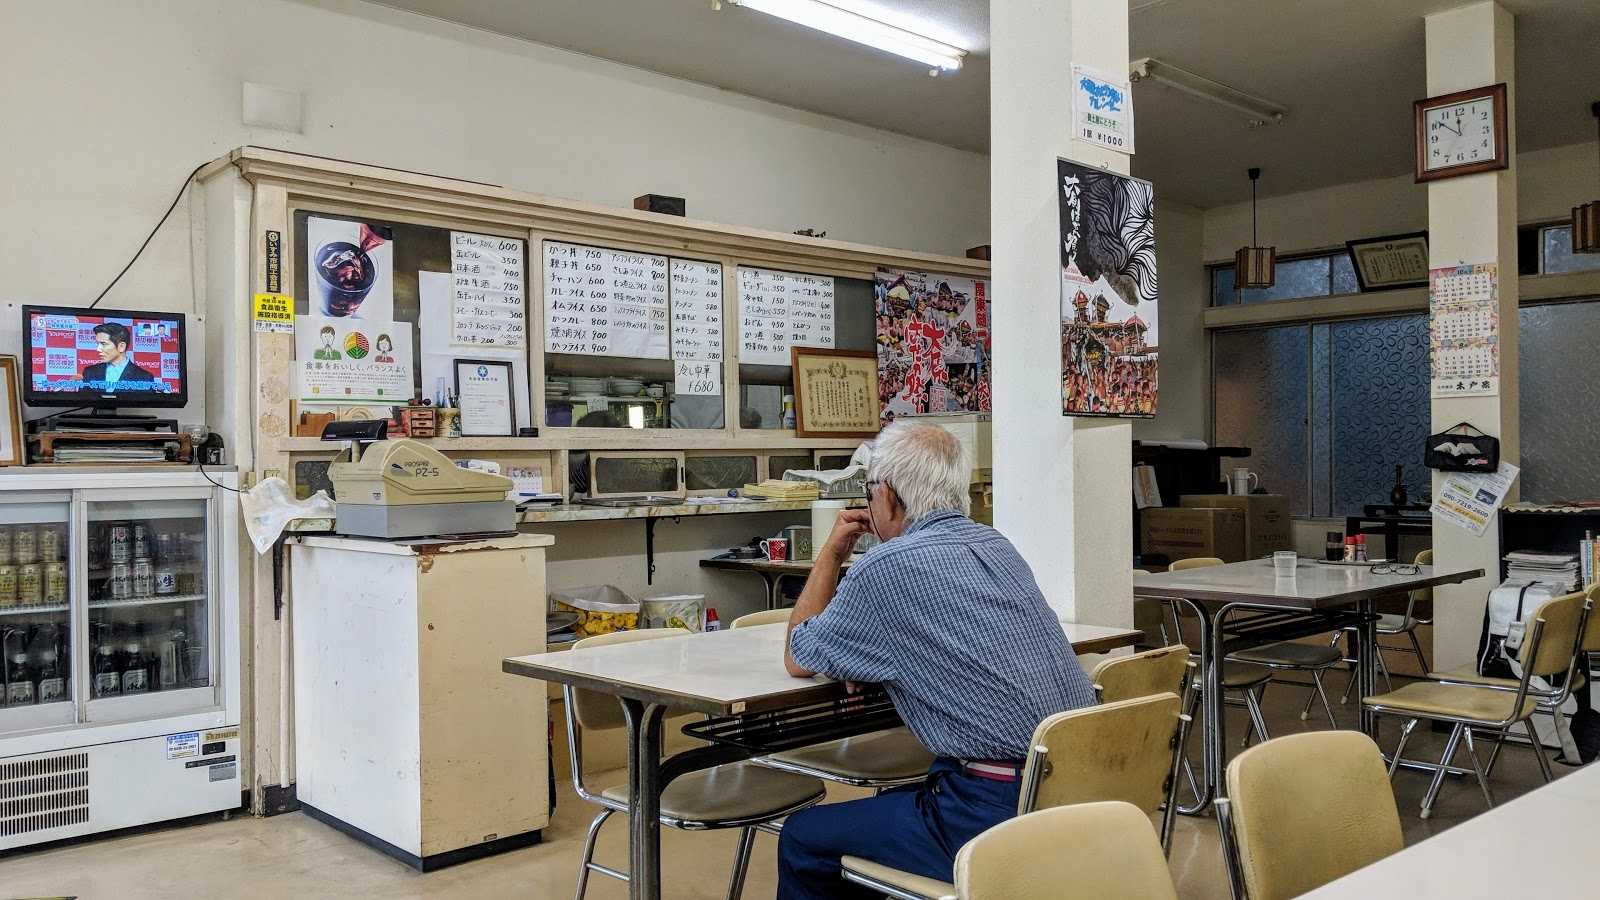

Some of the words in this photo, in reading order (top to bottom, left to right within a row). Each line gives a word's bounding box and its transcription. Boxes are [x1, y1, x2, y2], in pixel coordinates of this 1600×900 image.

[498, 241, 518, 251] 600
[549, 246, 577, 257] かつ丼
[585, 249, 602, 259] 750
[500, 257, 518, 265] 350
[551, 258, 578, 271] 親子丼
[585, 263, 602, 271] 650
[457, 264, 480, 274] 日本酒
[503, 268, 519, 277] 400
[551, 272, 583, 284] チャーハン
[588, 277, 605, 286] 600
[503, 281, 519, 291] 750
[551, 287, 585, 298] カレーライス
[590, 290, 607, 299] 600
[503, 296, 520, 305] 350
[552, 300, 585, 312] オムライス
[509, 310, 523, 319] 300
[651, 309, 665, 318] 750
[552, 316, 585, 325] かつカレー
[591, 317, 607, 326] 800
[507, 323, 523, 332] 200
[552, 342, 586, 353] かつライス
[591, 344, 607, 353] 900
[706, 352, 720, 360] 580
[305, 361, 406, 374] 食事をおいしく、バランスよく
[677, 363, 712, 379] 冷し中華
[688, 380, 714, 393] ¥680
